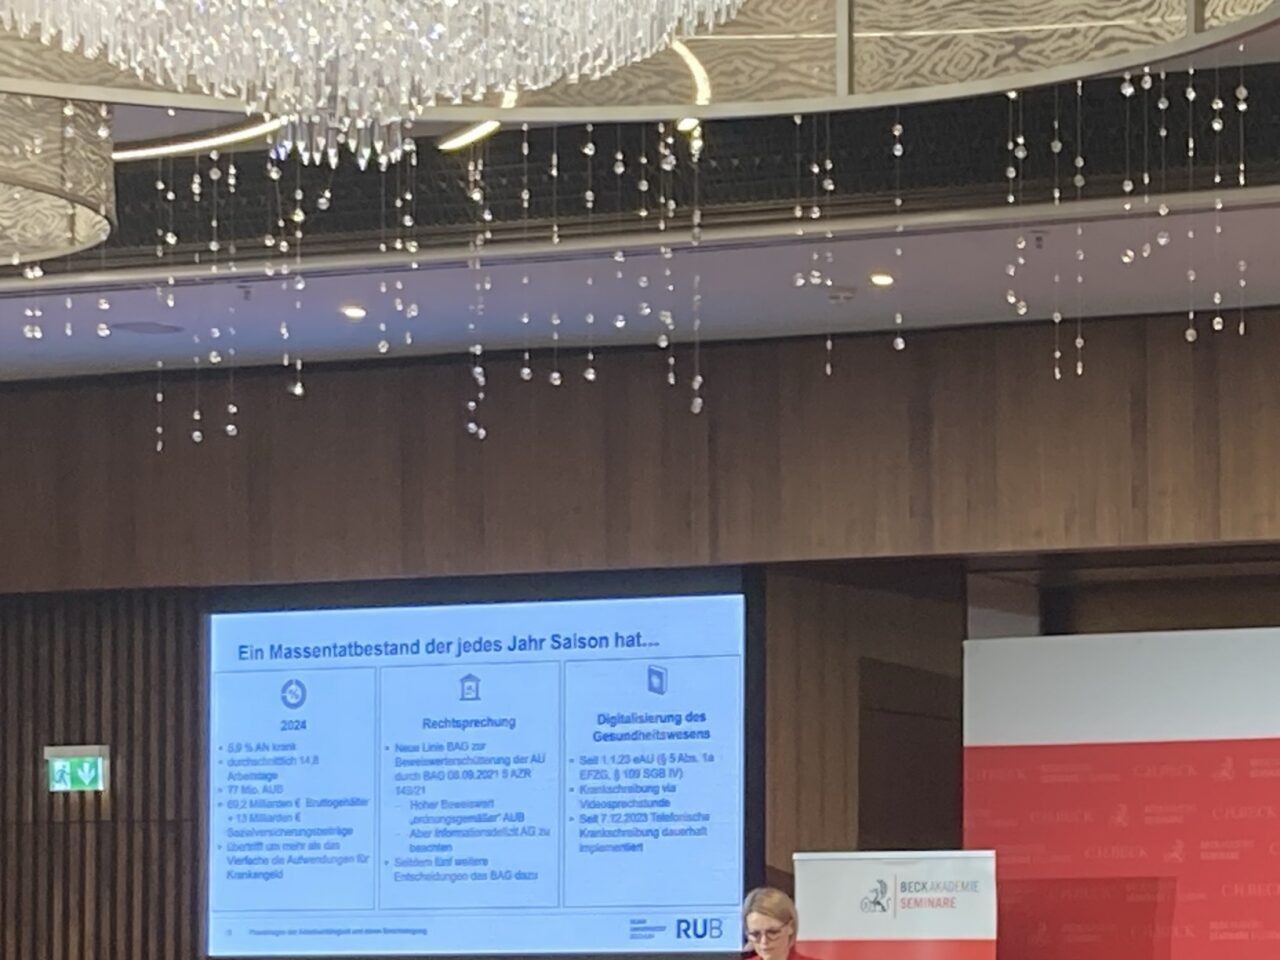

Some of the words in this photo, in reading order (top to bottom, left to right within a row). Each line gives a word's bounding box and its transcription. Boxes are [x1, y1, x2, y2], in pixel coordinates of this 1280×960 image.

[238, 645, 264, 660] Ein
[269, 639, 421, 660] Massentatbestand
[425, 639, 452, 654] der
[456, 637, 502, 658] jedes
[507, 635, 545, 652] Jahr
[551, 634, 609, 650] Saison
[281, 720, 307, 731] 2024
[422, 716, 516, 731] Rechtsprechung
[597, 713, 682, 727] Digitalisierung
[685, 712, 706, 722] des
[593, 730, 710, 742] Gesundheitswesens
[901, 897, 957, 909] SEMINARE
[676, 918, 723, 939] RUB
